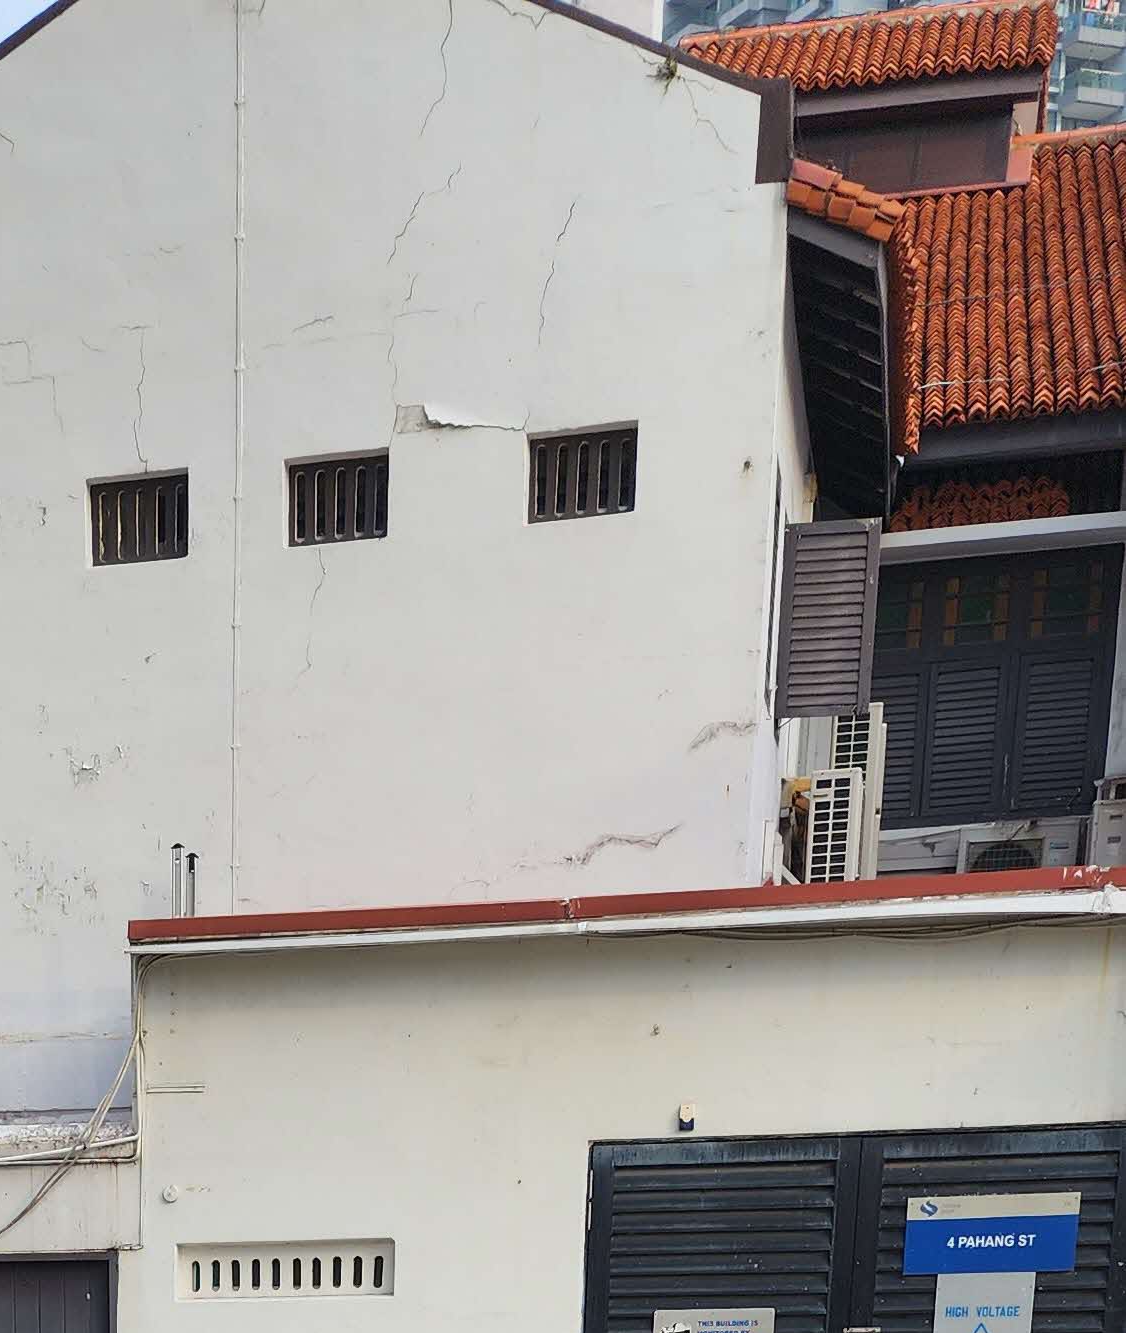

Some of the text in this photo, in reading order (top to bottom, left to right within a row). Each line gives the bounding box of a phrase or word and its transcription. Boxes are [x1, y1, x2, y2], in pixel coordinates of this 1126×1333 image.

[946, 1234, 1037, 1249] 4 PAHANG ST
[945, 1305, 1021, 1318] HIGH VOLTAGE
[715, 1319, 750, 1327] BUILDING
[751, 1319, 759, 1327] IS
